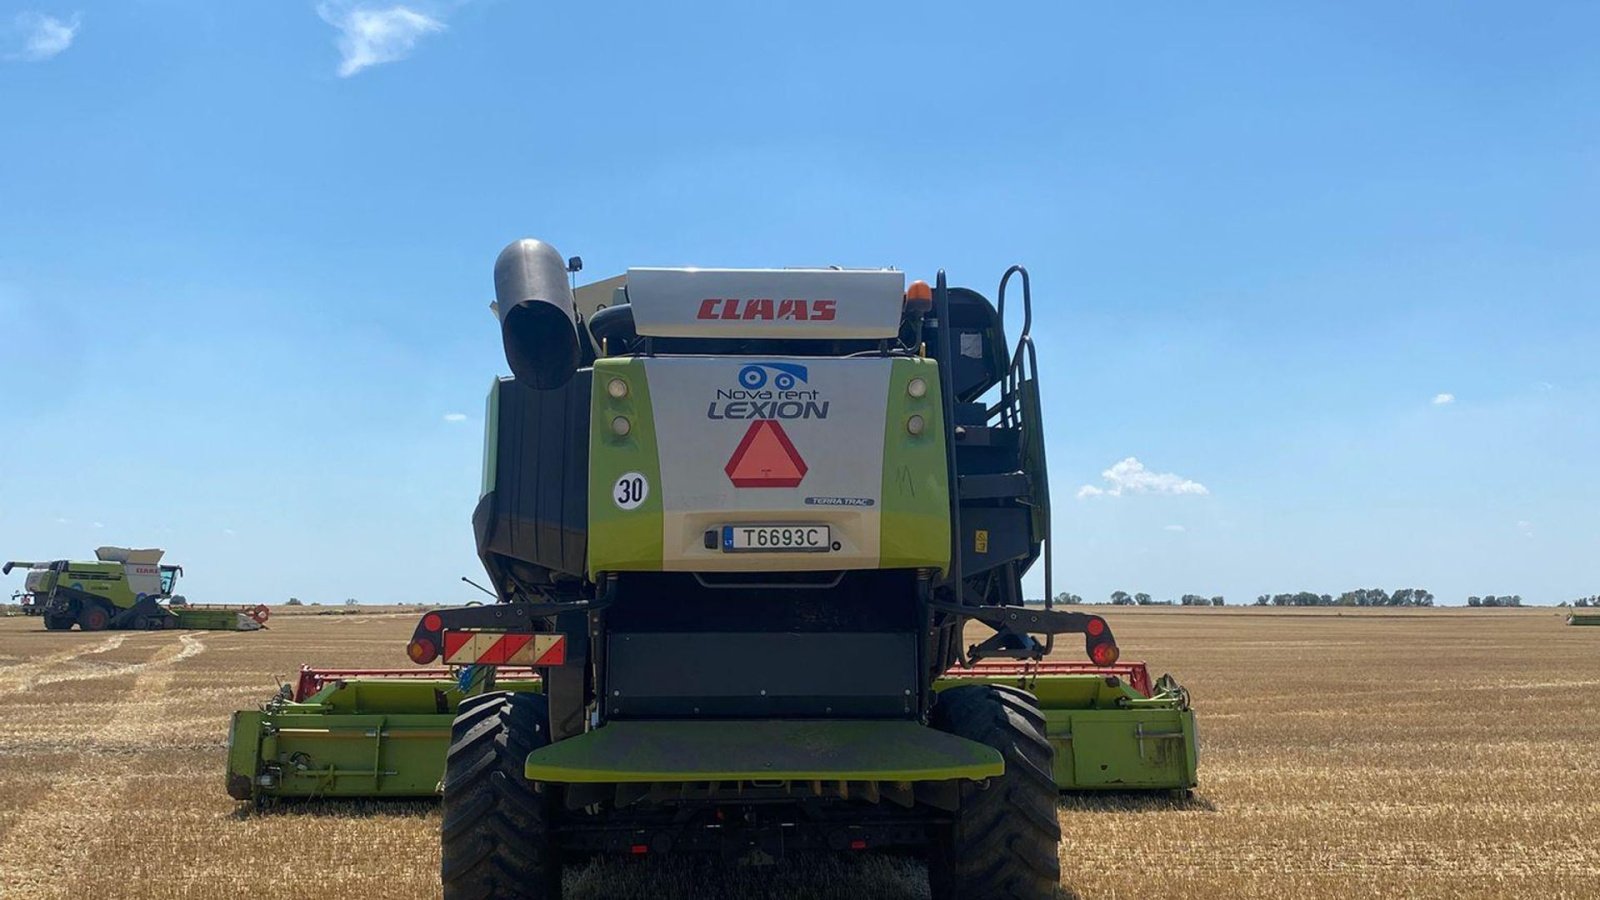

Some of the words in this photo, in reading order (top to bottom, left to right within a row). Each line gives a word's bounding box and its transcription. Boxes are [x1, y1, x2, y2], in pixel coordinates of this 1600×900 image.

[697, 299, 836, 320] CLAAS
[717, 389, 773, 400] Nova
[778, 389, 820, 400] rent
[707, 401, 830, 420] LEXION
[617, 477, 643, 503] 30
[813, 498, 842, 506] TERRA
[844, 499, 868, 507] TRAC
[743, 529, 819, 546] T6693C
